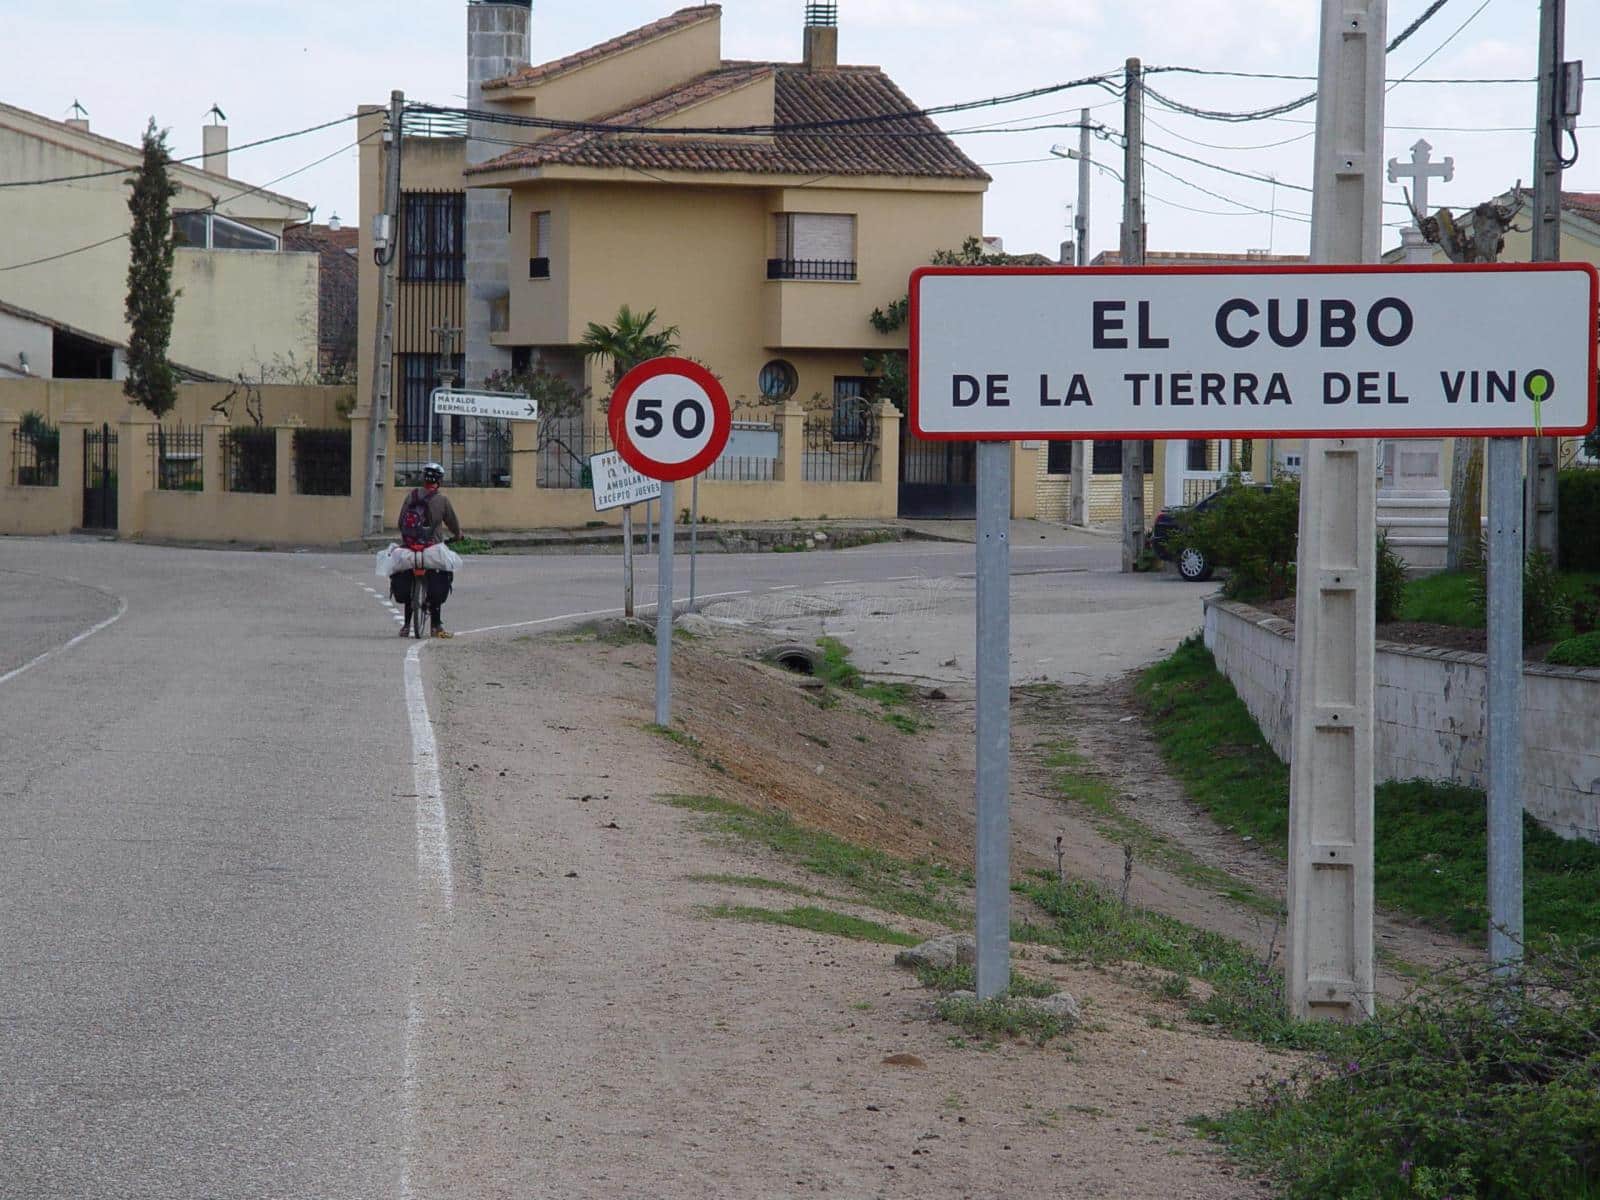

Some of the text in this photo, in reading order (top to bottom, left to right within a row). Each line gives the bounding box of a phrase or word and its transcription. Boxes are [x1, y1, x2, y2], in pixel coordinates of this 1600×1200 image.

[1093, 297, 1414, 349] EL CUBO
[437, 395, 476, 405] MAYALDE
[952, 368, 1556, 407] DE LA TIERRA DEL VINO
[437, 403, 478, 414] BERMILLO
[634, 398, 706, 439] 50
[598, 483, 660, 505] EXCEPTO JUEVES
